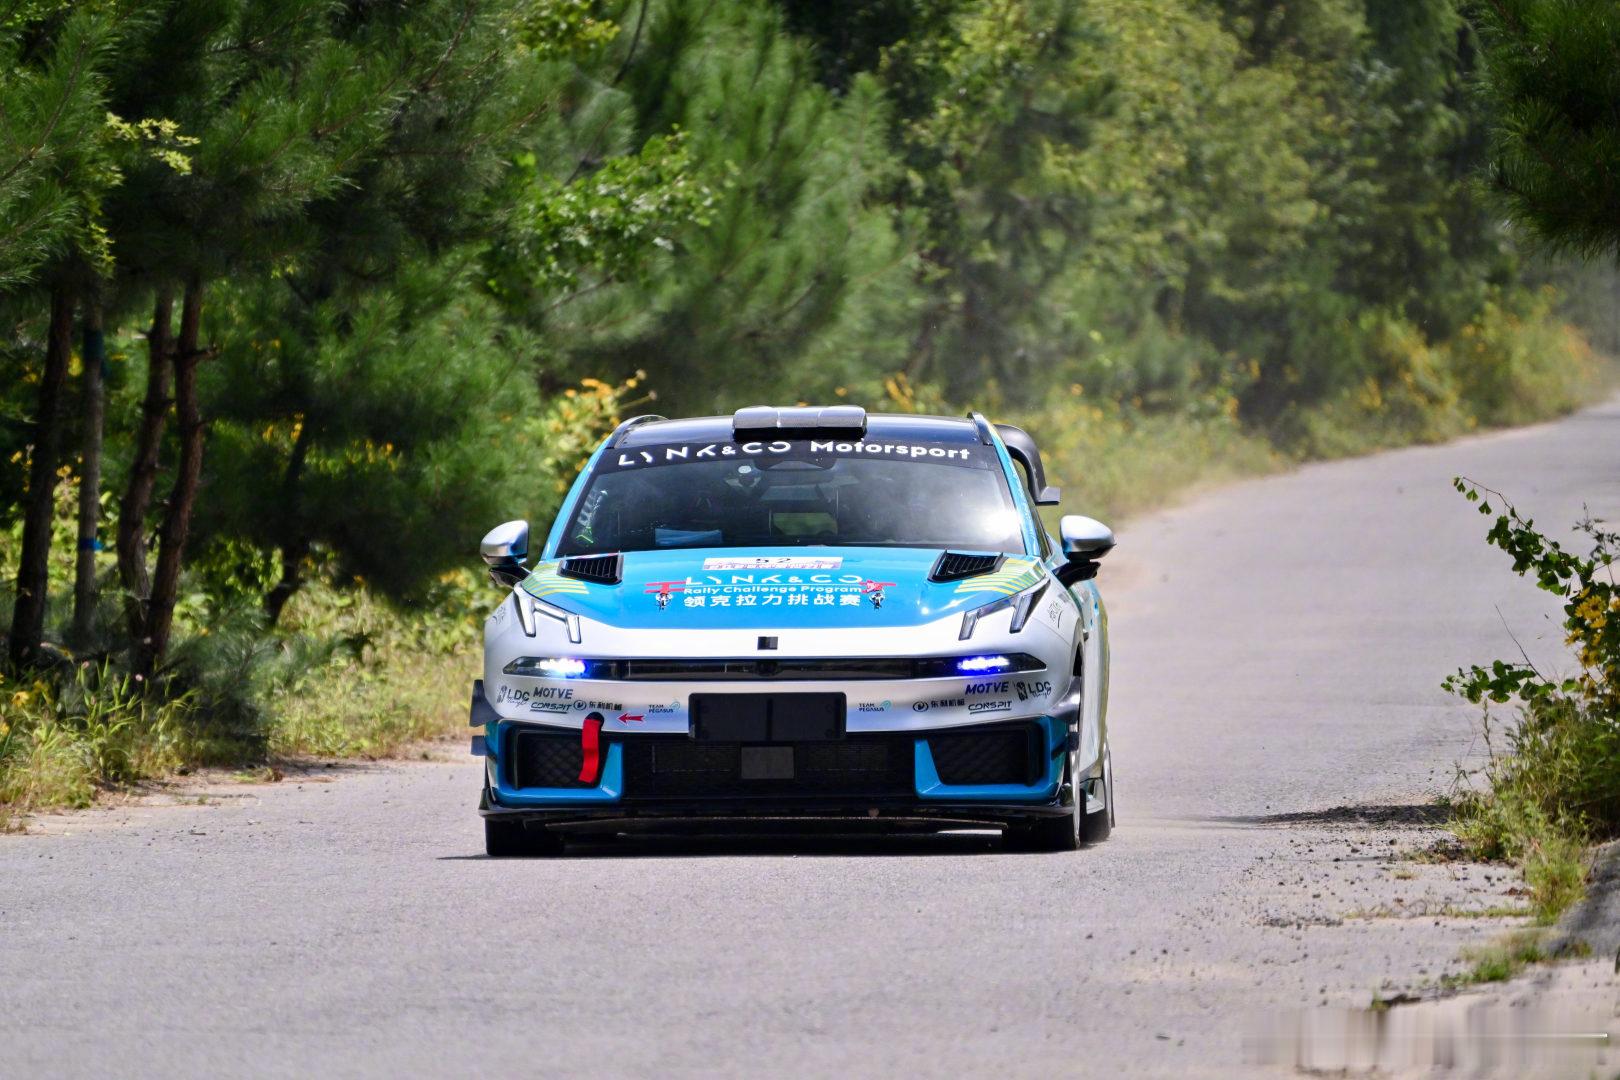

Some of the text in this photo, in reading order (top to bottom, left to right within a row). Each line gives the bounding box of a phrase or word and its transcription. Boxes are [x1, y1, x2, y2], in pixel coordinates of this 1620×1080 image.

[618, 440, 970, 466] LYNK&CO Motorsport
[685, 574, 863, 586] LYNK&CO
[683, 585, 862, 595] Rally Challenge Program
[683, 594, 861, 607] 领克拉力挑战赛
[533, 687, 574, 700] MOTVE
[965, 681, 1009, 695] MOTVE
[1027, 681, 1052, 694] LDC
[507, 688, 530, 702] LDC
